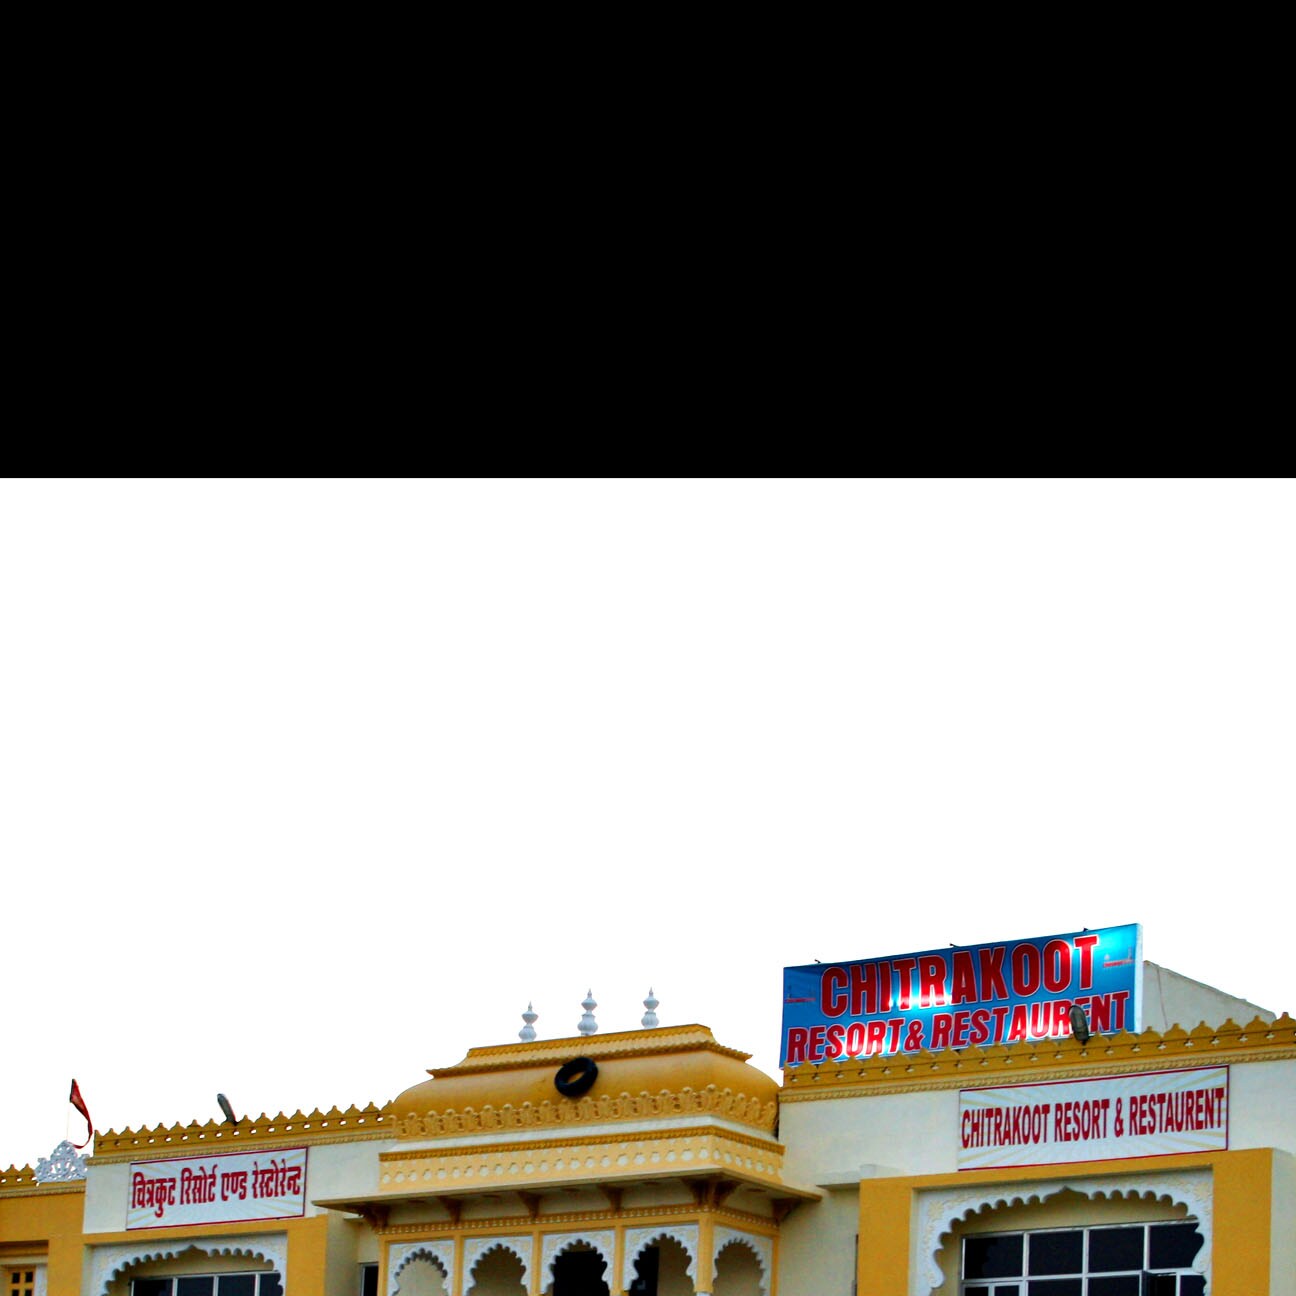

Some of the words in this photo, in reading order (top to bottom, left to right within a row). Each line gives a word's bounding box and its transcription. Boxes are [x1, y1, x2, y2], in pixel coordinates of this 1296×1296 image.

[821, 934, 1100, 1018] CHITRAKOOT
[786, 1018, 905, 1063] RESORT
[961, 1103, 1050, 1149] CHITRAKOOT
[1054, 1099, 1110, 1143] RESORT
[1114, 1097, 1124, 1138] &
[1129, 1087, 1225, 1137] RESTAURENT
[180, 1164, 218, 1205] रिसोर्ट
[221, 1171, 247, 1201] एण्ड
